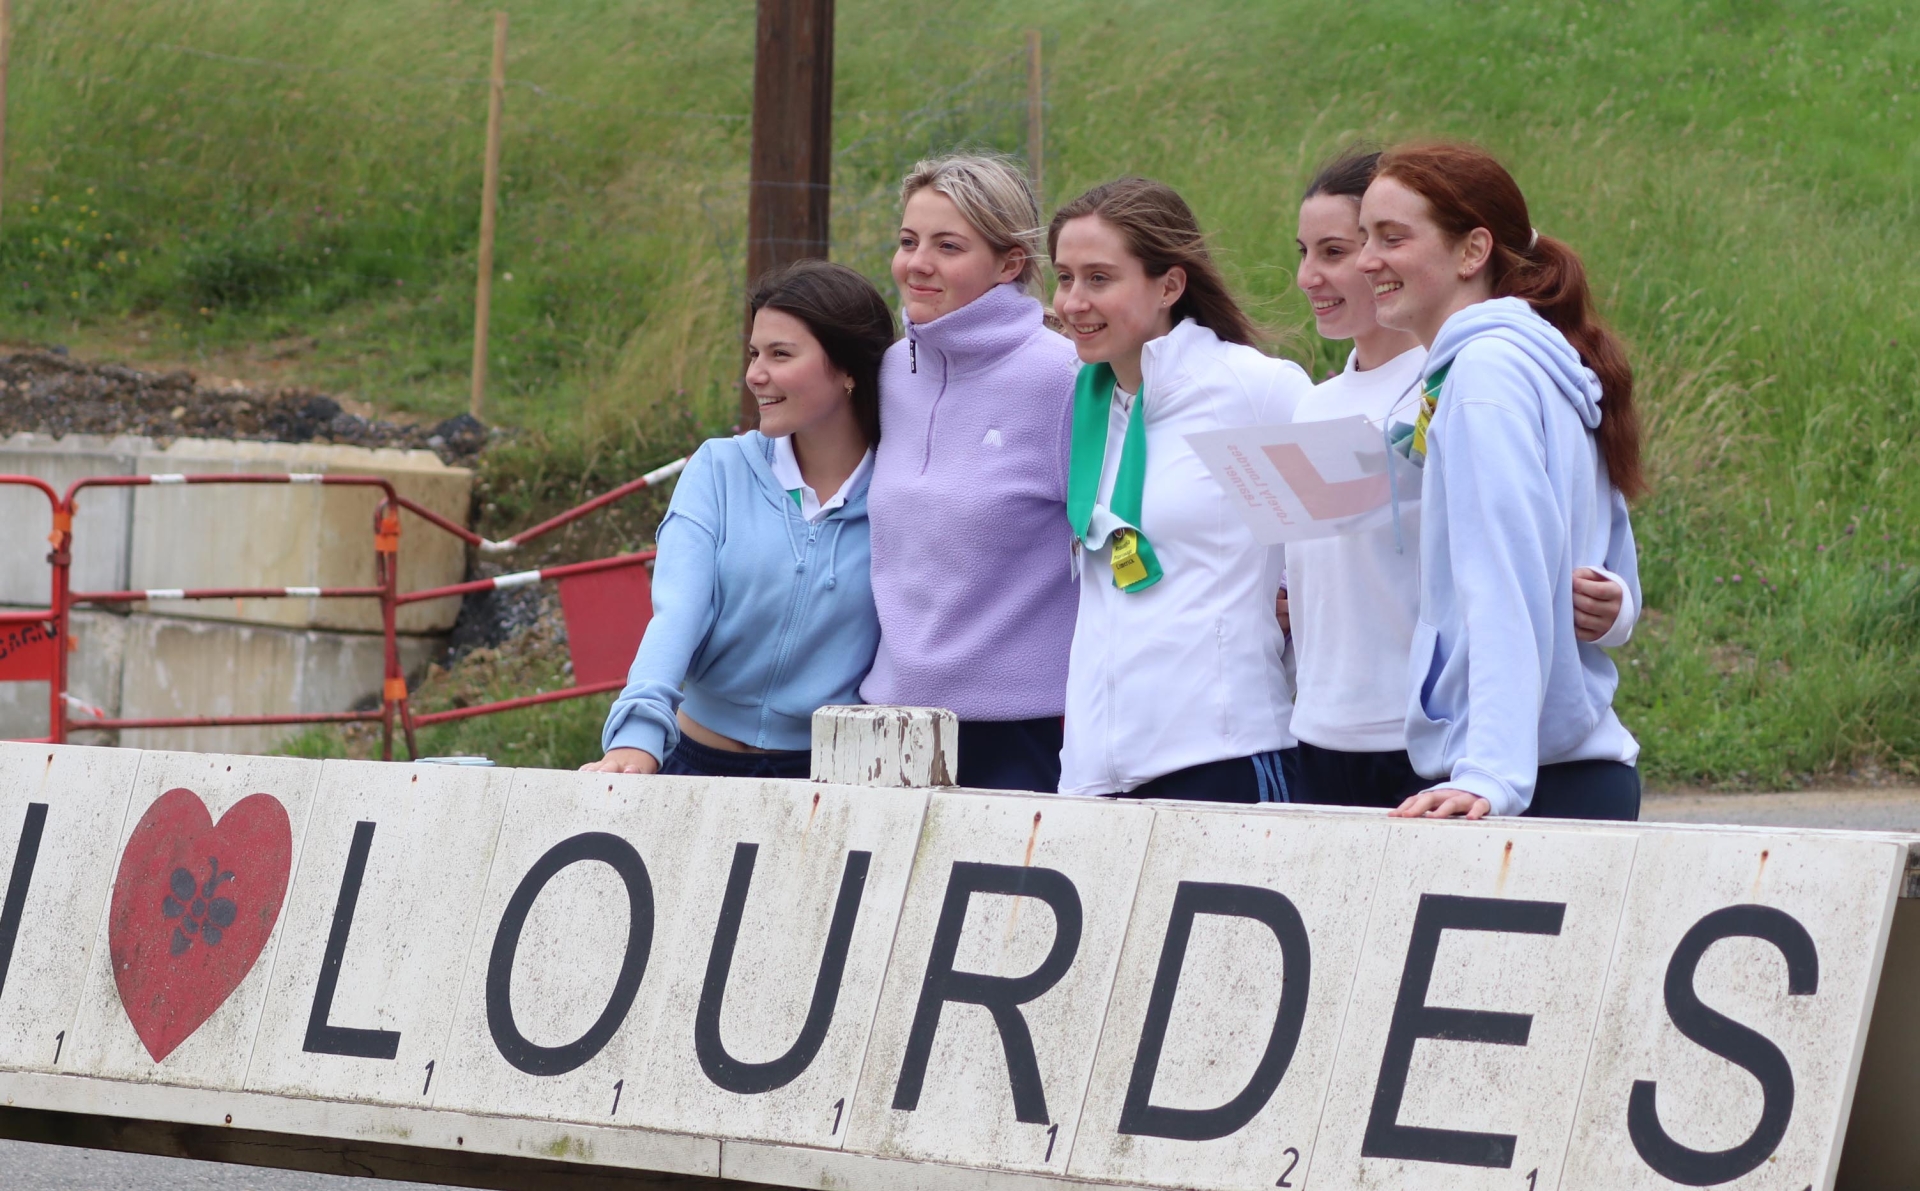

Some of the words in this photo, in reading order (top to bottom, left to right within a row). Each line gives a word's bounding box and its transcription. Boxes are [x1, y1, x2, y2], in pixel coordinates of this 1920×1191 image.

[303, 821, 1818, 1187] LOURDES
[54, 1031, 65, 1064] 1
[424, 1060, 434, 1095] 1
[612, 1080, 623, 1115] 1
[833, 1098, 844, 1135] 1
[1045, 1124, 1058, 1162] 1
[1276, 1148, 1298, 1187] 2
